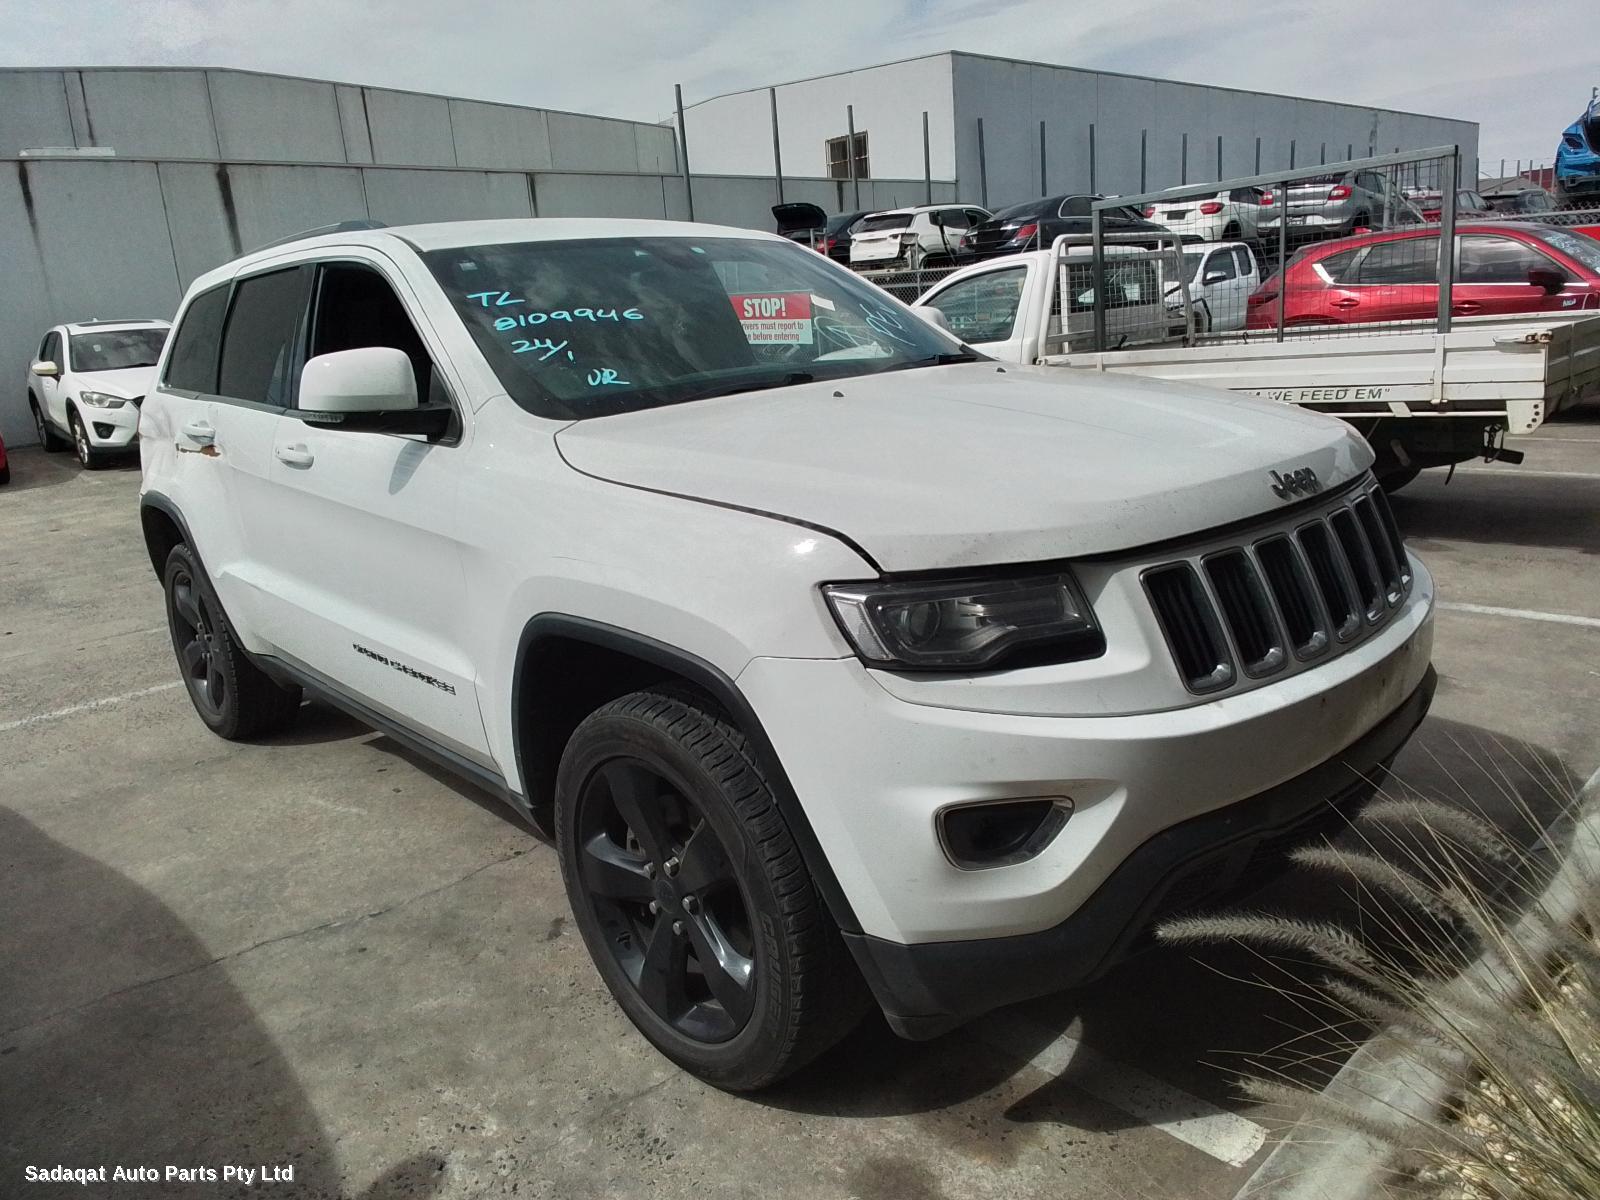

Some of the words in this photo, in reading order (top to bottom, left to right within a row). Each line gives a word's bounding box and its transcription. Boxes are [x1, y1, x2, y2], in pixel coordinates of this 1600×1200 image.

[743, 297, 787, 318] STOP!
[493, 308, 645, 331] 8109946
[760, 321, 777, 331] must
[777, 321, 797, 332] report
[797, 321, 804, 331] to
[752, 332, 773, 341] before
[773, 332, 800, 342] entering
[1300, 388, 1349, 401] FEED
[1269, 467, 1321, 500] Jeep
